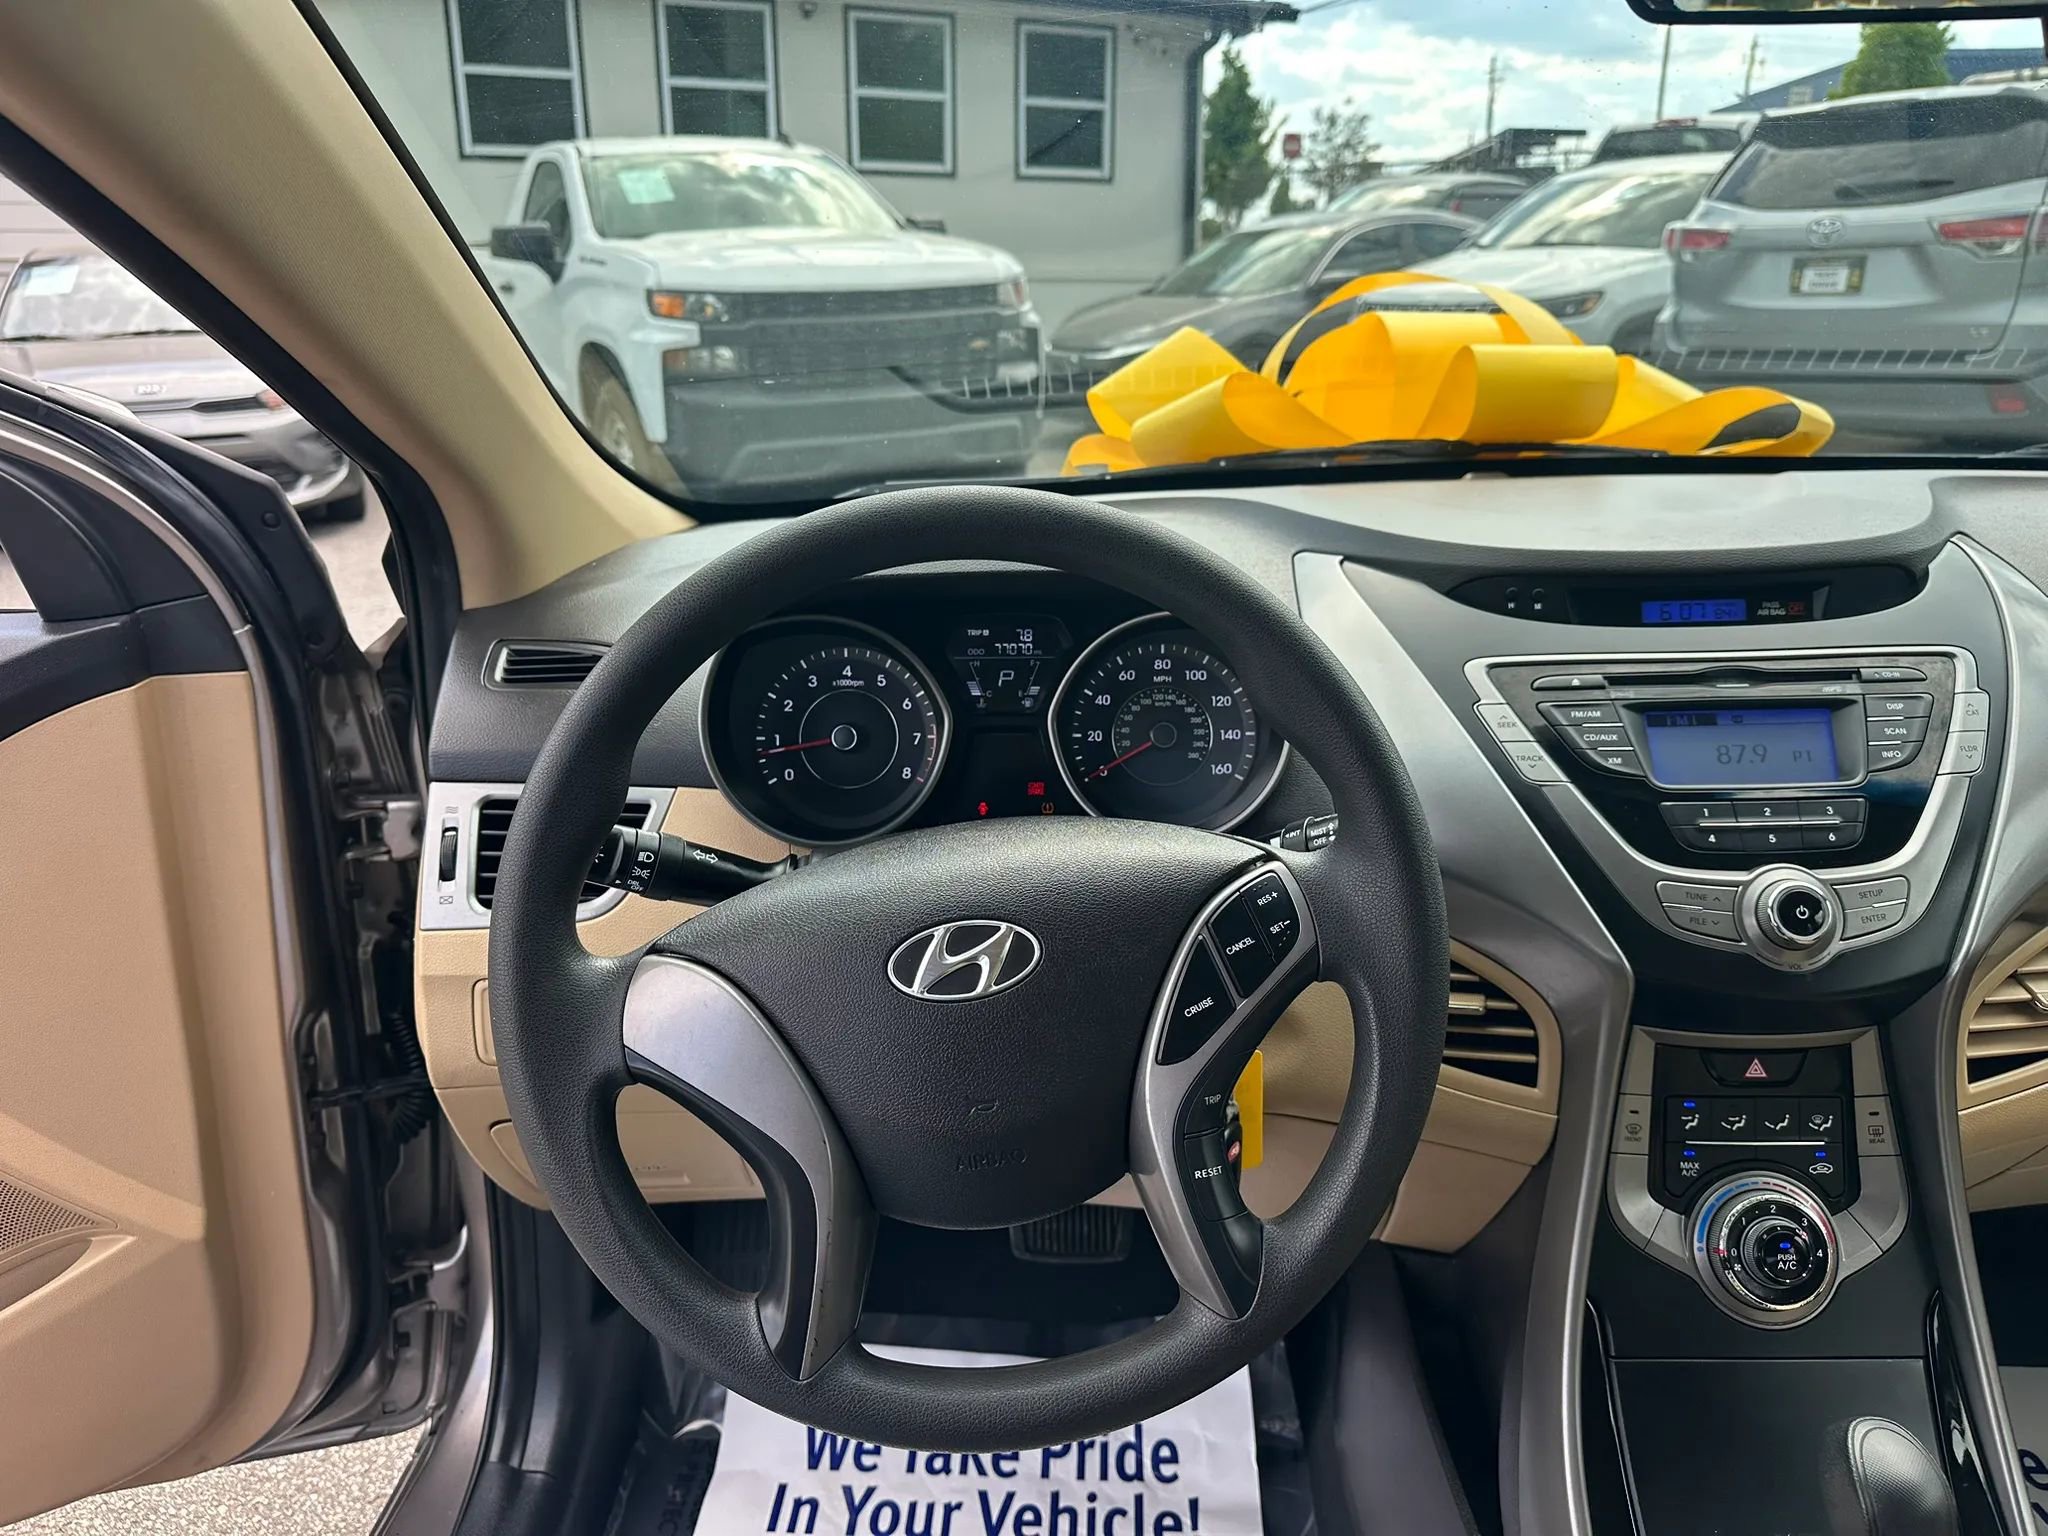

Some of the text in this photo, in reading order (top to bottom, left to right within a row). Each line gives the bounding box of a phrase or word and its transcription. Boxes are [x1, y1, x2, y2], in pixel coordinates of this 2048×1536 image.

[994, 643, 1033, 656] 77070
[1154, 659, 1172, 670] 80
[842, 666, 852, 676] 4
[1118, 670, 1136, 681] 60
[1184, 670, 1207, 681] 100
[808, 675, 818, 687] 3
[877, 675, 887, 687] 5
[998, 670, 1015, 687] P
[902, 698, 912, 710] 6
[1094, 694, 1111, 706] 40
[1211, 696, 1232, 707] 120
[784, 700, 793, 712] 2
[1571, 710, 1601, 718] FM/AM
[774, 734, 780, 746] 1
[912, 733, 921, 745] 7
[1087, 730, 1103, 742] 20
[1219, 729, 1241, 740] 140
[1583, 734, 1618, 742] CD/AUX
[1716, 743, 1768, 765] 87.9
[1607, 757, 1622, 765] XM
[902, 767, 912, 779] 8
[1210, 763, 1233, 775] 160
[784, 769, 794, 781] 0
[1703, 808, 1709, 816] 1
[1763, 807, 1772, 816] 2
[1826, 806, 1834, 815] 3
[1290, 829, 1301, 838] INT
[1310, 826, 1328, 837] MIST
[1828, 833, 1836, 841] 6
[1313, 836, 1327, 846] OFF
[1708, 834, 1717, 843] 4
[1768, 834, 1776, 843] 5
[1685, 892, 1708, 901] TUNE
[1858, 888, 1884, 899] SETUP
[1689, 916, 1707, 926] FILE
[1861, 913, 1887, 924] ENTER
[1226, 937, 1256, 955] CANCEL
[1184, 996, 1215, 1017] CRUISE
[1204, 1094, 1222, 1106] TRIP
[1680, 1161, 1700, 1169] MAX
[1194, 1166, 1223, 1180] RESET
[1681, 1169, 1698, 1177] A/C
[1770, 1205, 1776, 1214] 2
[1742, 1217, 1746, 1225] 1
[1801, 1218, 1808, 1226] 3
[1731, 1249, 1738, 1257] 0
[1816, 1249, 1823, 1257] 4
[1777, 1261, 1797, 1270] A/C
[807, 1424, 881, 1473] We
[1041, 1424, 1180, 1483] Pride
[766, 1483, 820, 1534] In
[842, 1485, 963, 1536] Your
[978, 1490, 1199, 1536] Vehicle!
